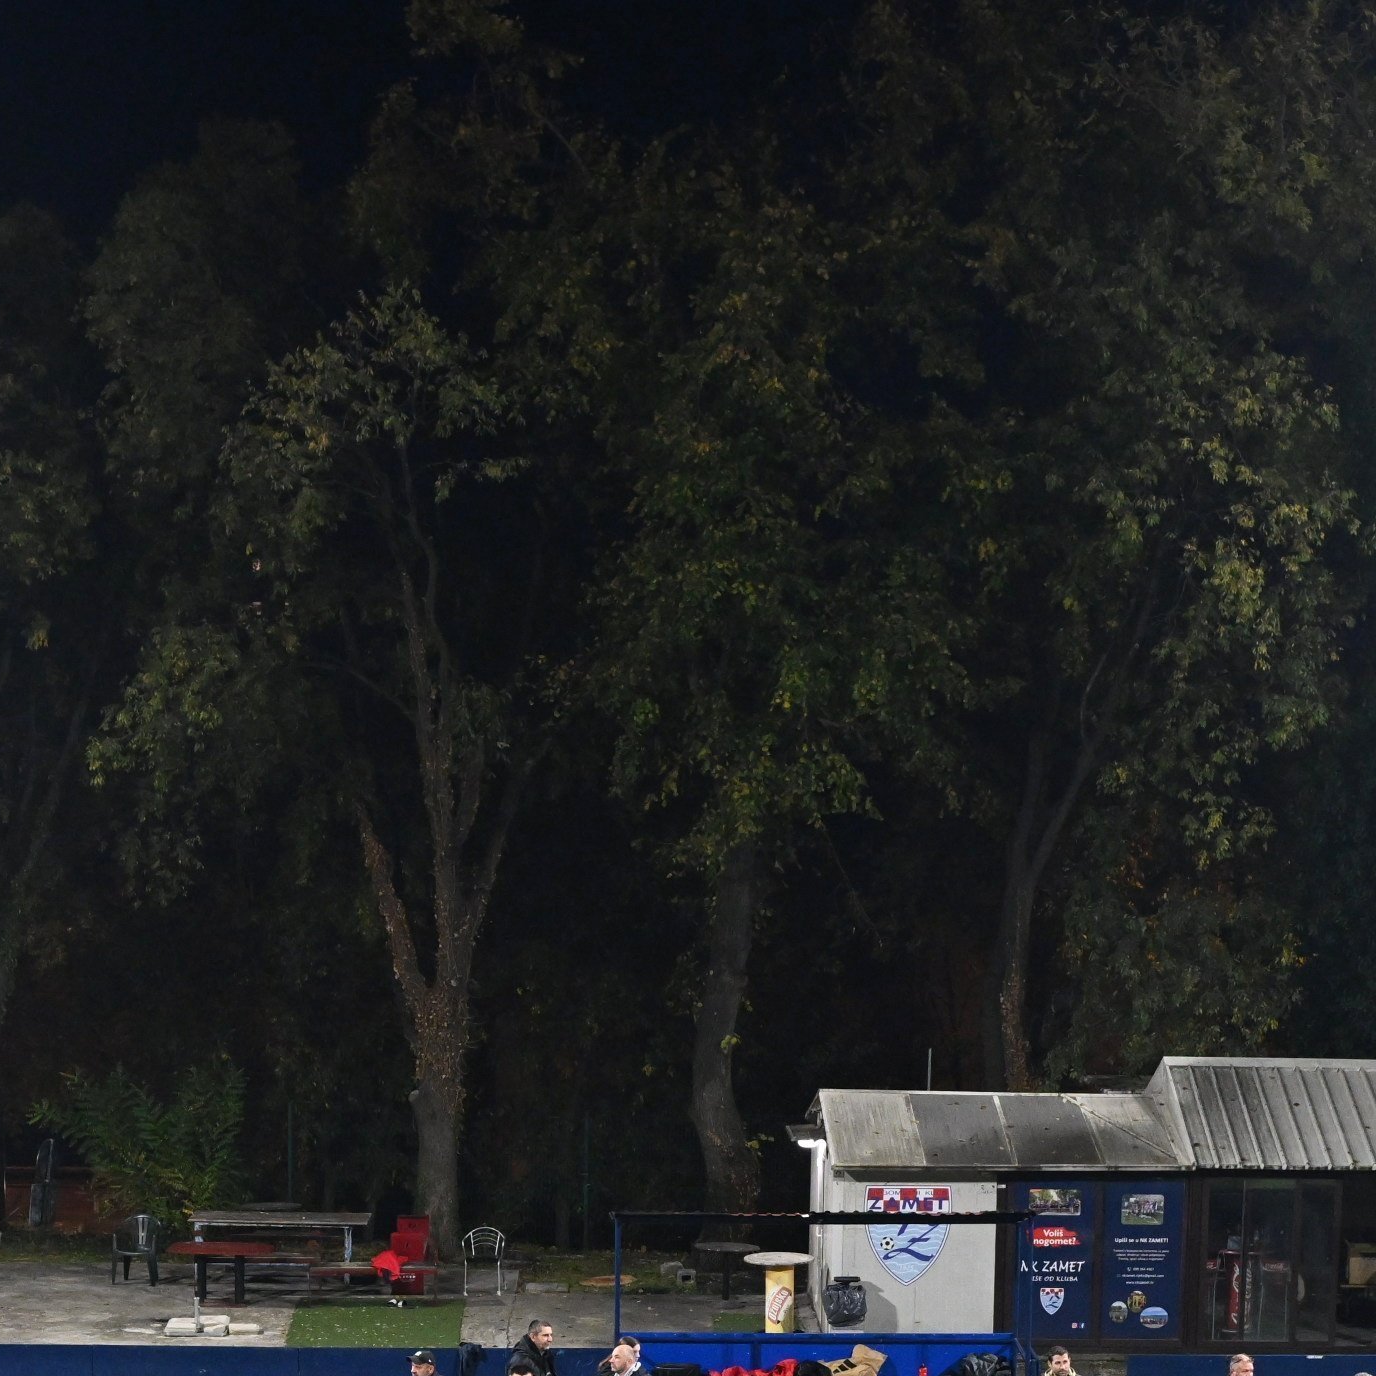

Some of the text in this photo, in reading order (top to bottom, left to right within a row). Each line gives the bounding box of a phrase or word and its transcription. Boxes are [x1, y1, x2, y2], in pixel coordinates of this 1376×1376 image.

[869, 1197, 946, 1210] ZAMET
[1043, 1229, 1064, 1237] Voliš
[1033, 1237, 1077, 1247] nogomet?
[1042, 1260, 1085, 1273] ZAMET
